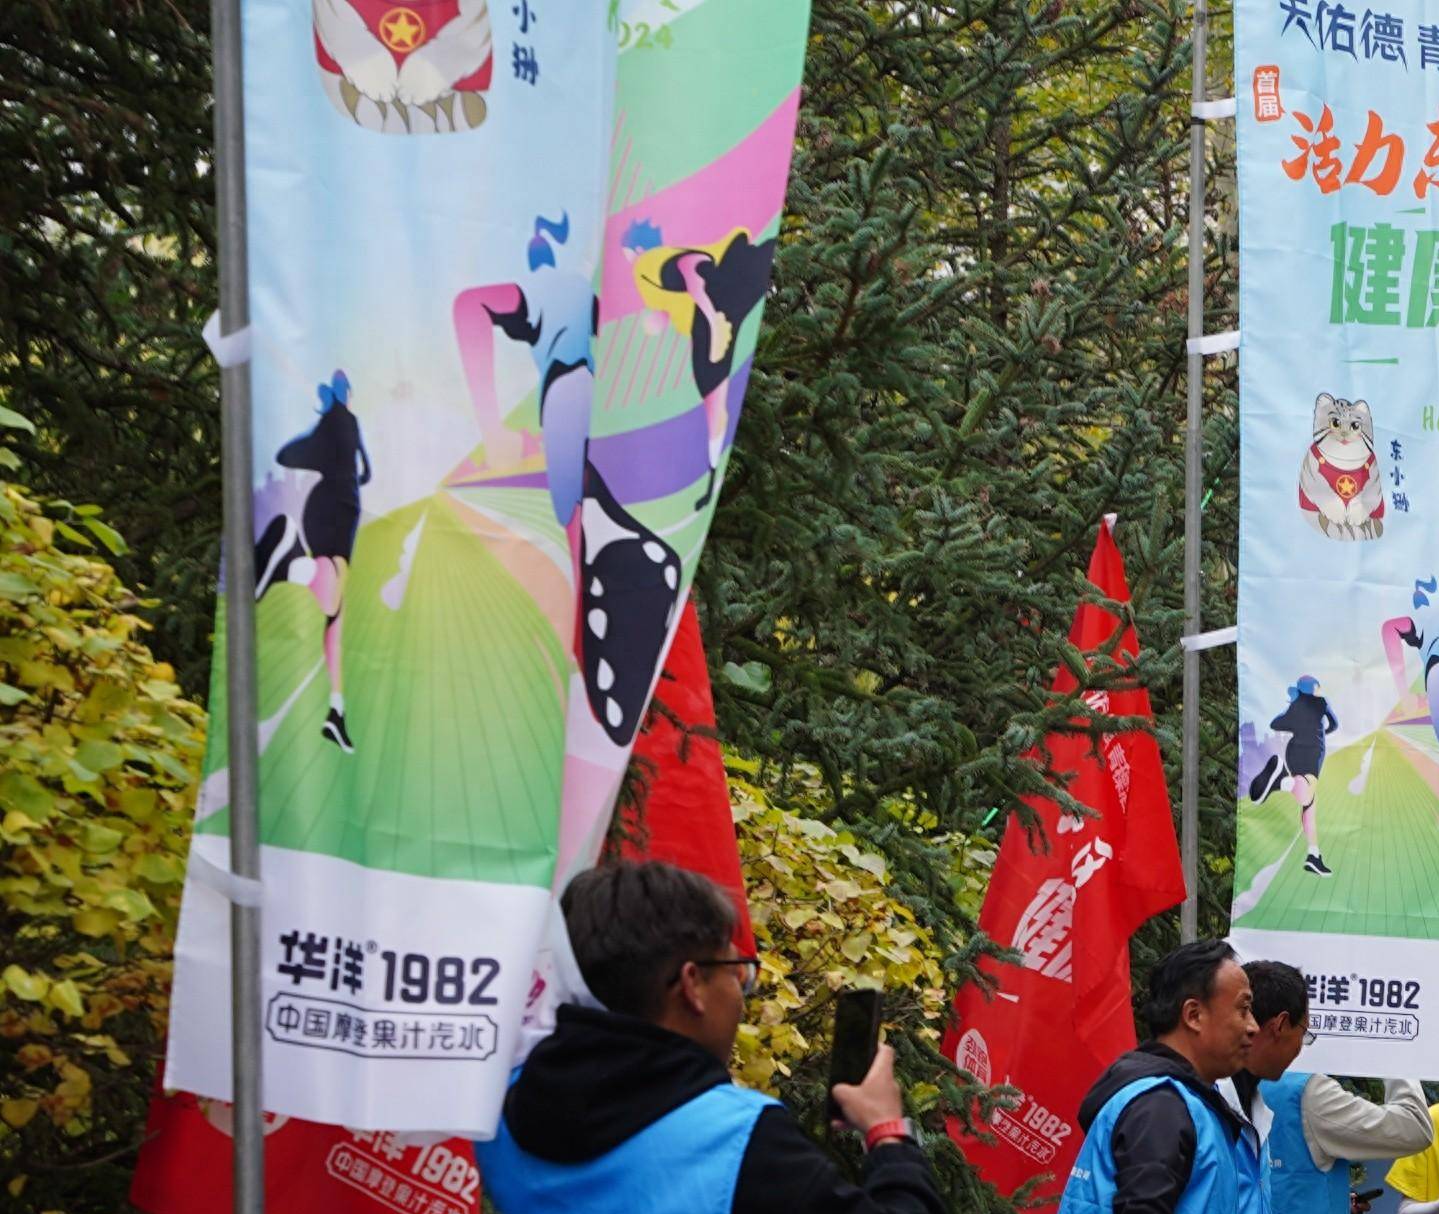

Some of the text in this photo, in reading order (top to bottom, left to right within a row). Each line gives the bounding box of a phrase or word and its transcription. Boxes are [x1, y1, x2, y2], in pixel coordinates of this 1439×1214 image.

[1256, 70, 1280, 118] 首届
[276, 1003, 485, 1051] 中国摩登果汁汽水
[1308, 1013, 1413, 1035] 国摩登果汁汽水
